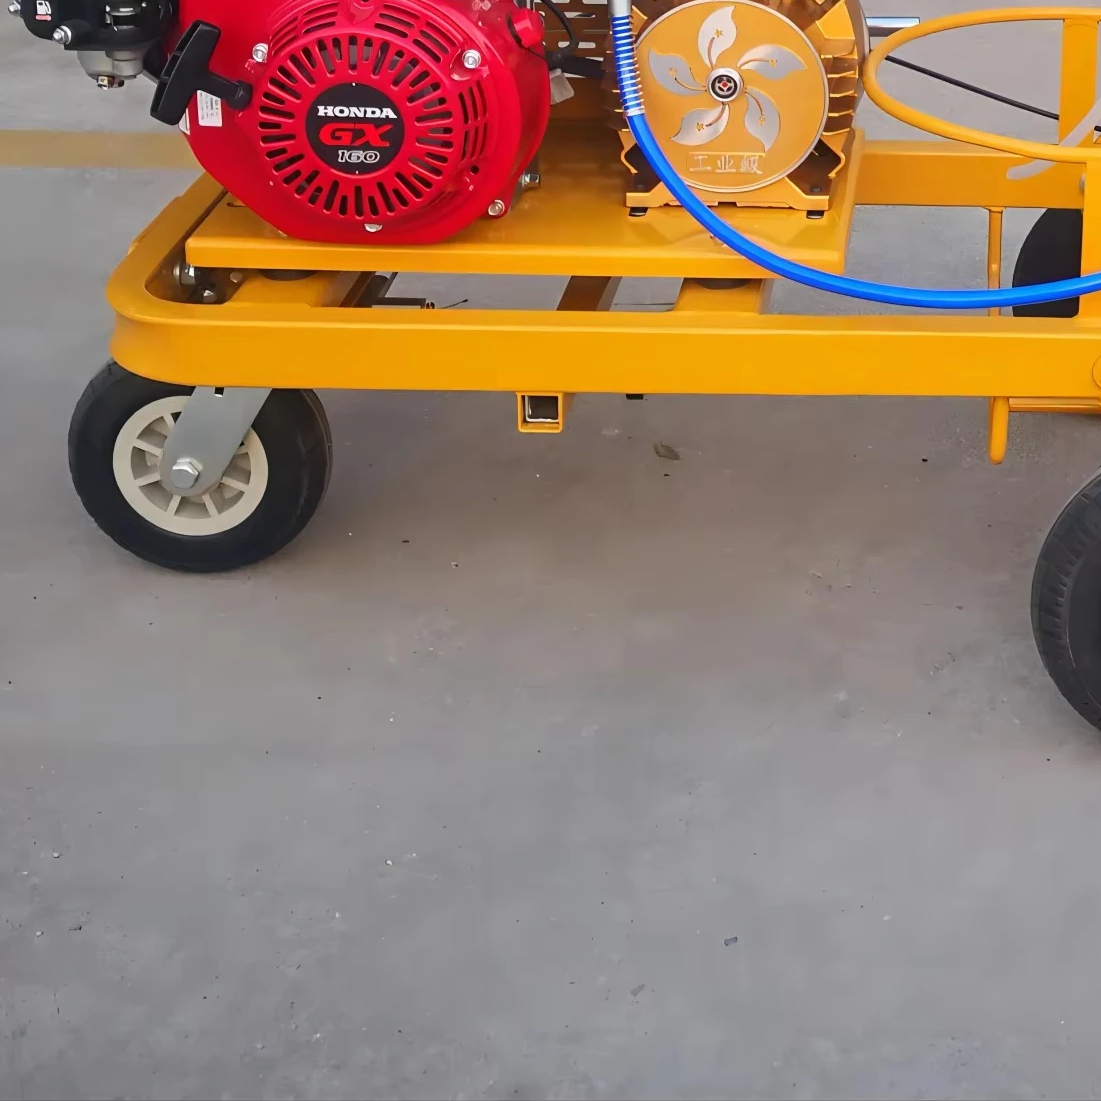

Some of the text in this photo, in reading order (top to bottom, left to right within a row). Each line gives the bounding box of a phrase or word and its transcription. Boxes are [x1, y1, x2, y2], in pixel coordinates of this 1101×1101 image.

[317, 105, 398, 119] HONDA
[318, 122, 394, 147] GX
[337, 149, 380, 163] 160
